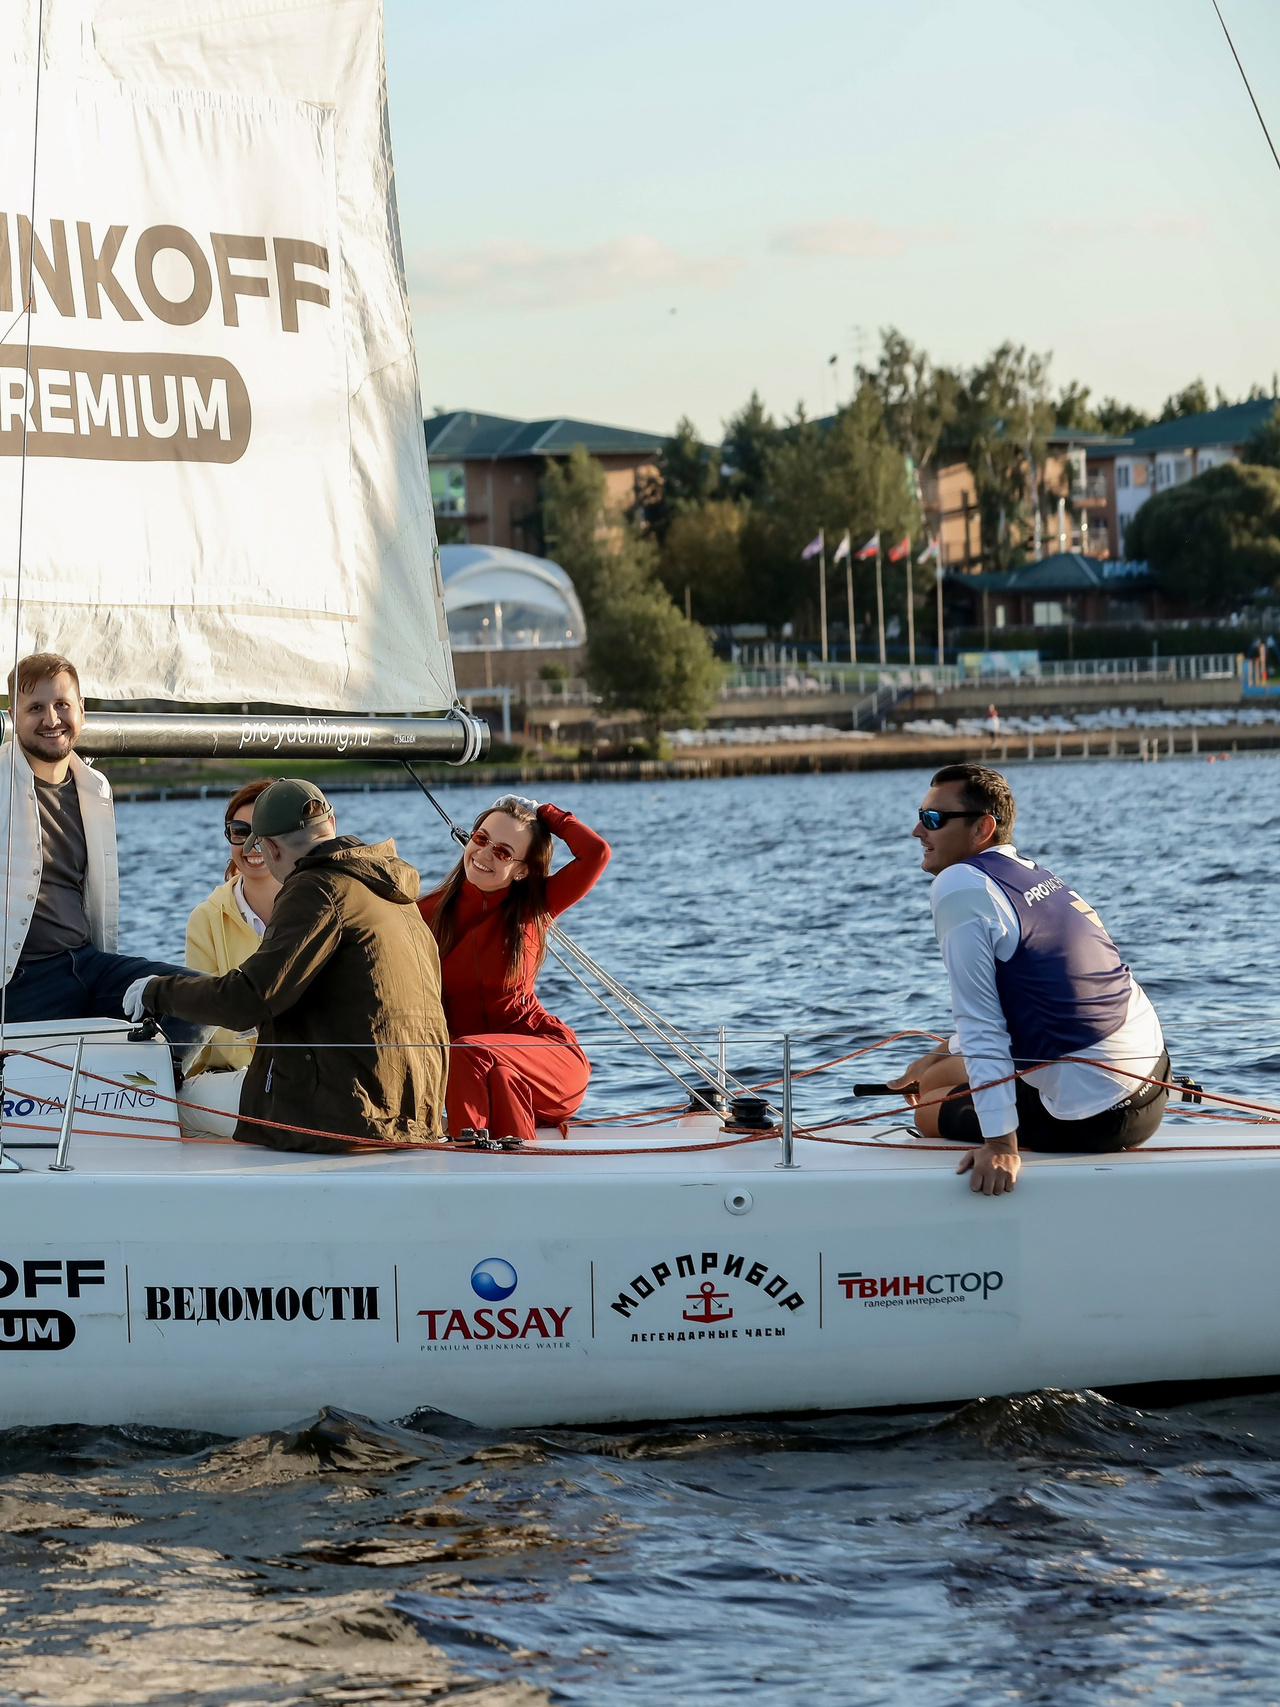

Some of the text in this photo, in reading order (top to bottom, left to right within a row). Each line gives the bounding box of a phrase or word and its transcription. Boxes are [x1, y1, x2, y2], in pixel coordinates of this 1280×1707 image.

[239, 718, 371, 751] pro-yachting.ru
[1108, 1099, 1132, 1111] UGO
[610, 1252, 805, 1318] МОРПРИБОР
[144, 1285, 380, 1325] ВЕДОМОСТИ
[864, 1294, 966, 1308] галерея интерьеров
[417, 1307, 573, 1340] TASSAY
[630, 1327, 786, 1342] ЛЕГЕНДАРНЫЕ ЧАСЫ
[421, 1344, 470, 1352] PREMIUM
